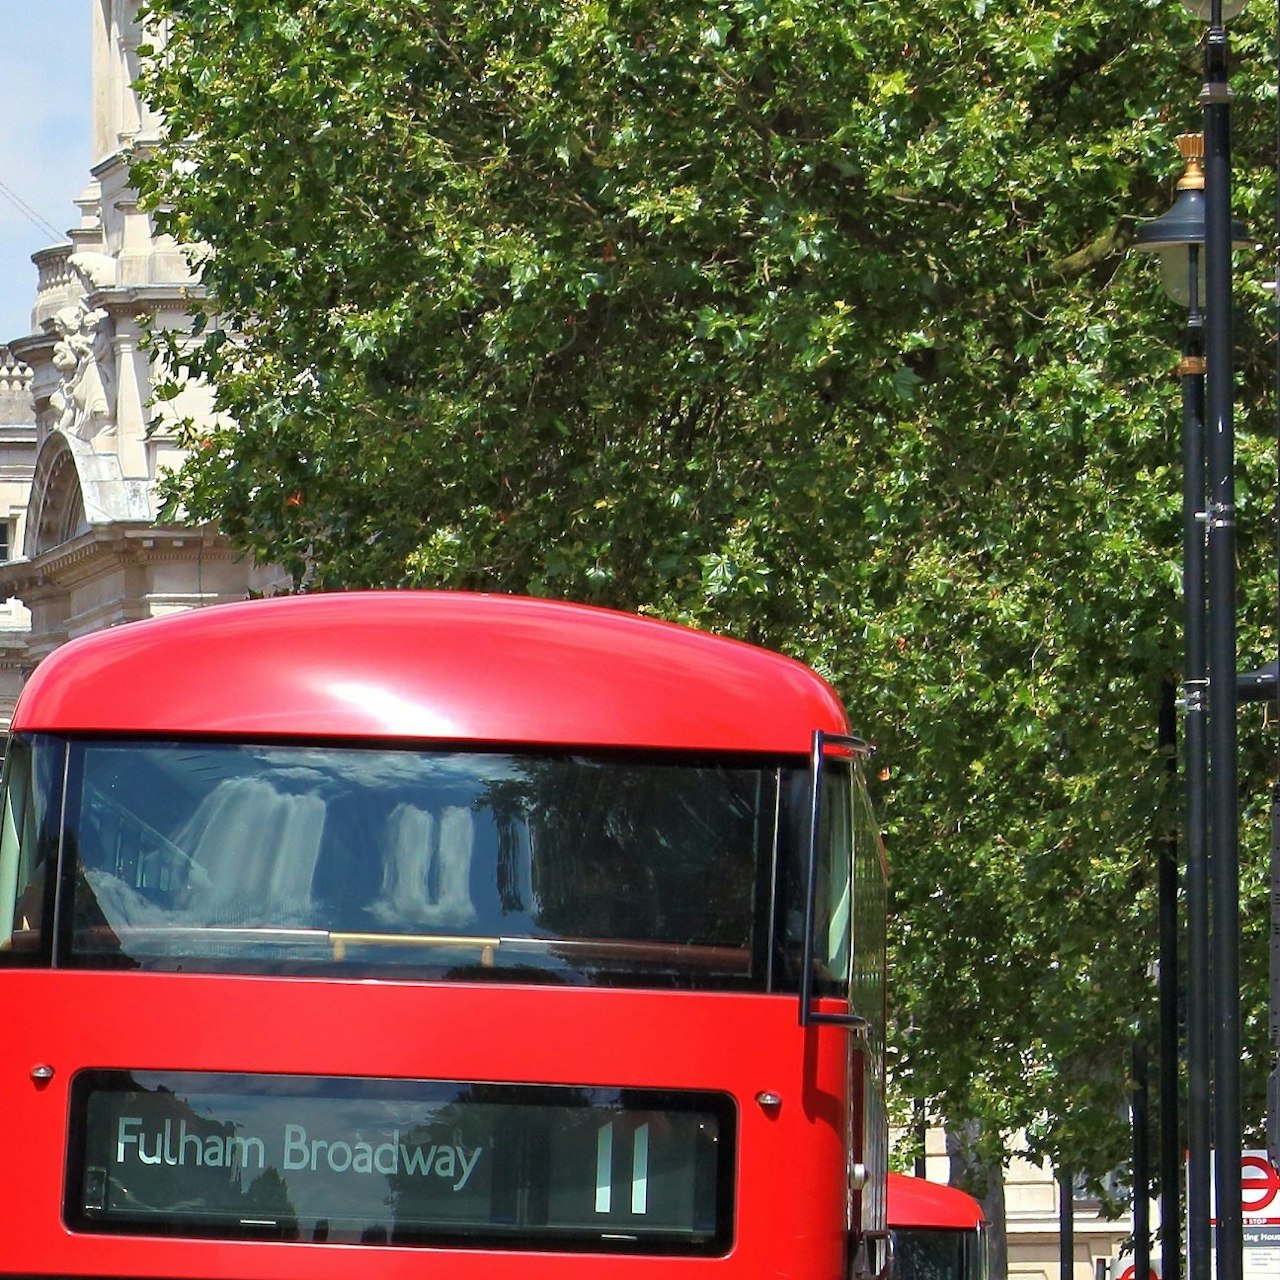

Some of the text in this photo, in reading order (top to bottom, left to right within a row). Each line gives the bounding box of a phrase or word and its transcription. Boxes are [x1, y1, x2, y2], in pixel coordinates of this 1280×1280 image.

[116, 1117, 649, 1215] Fulham Broadway 11
